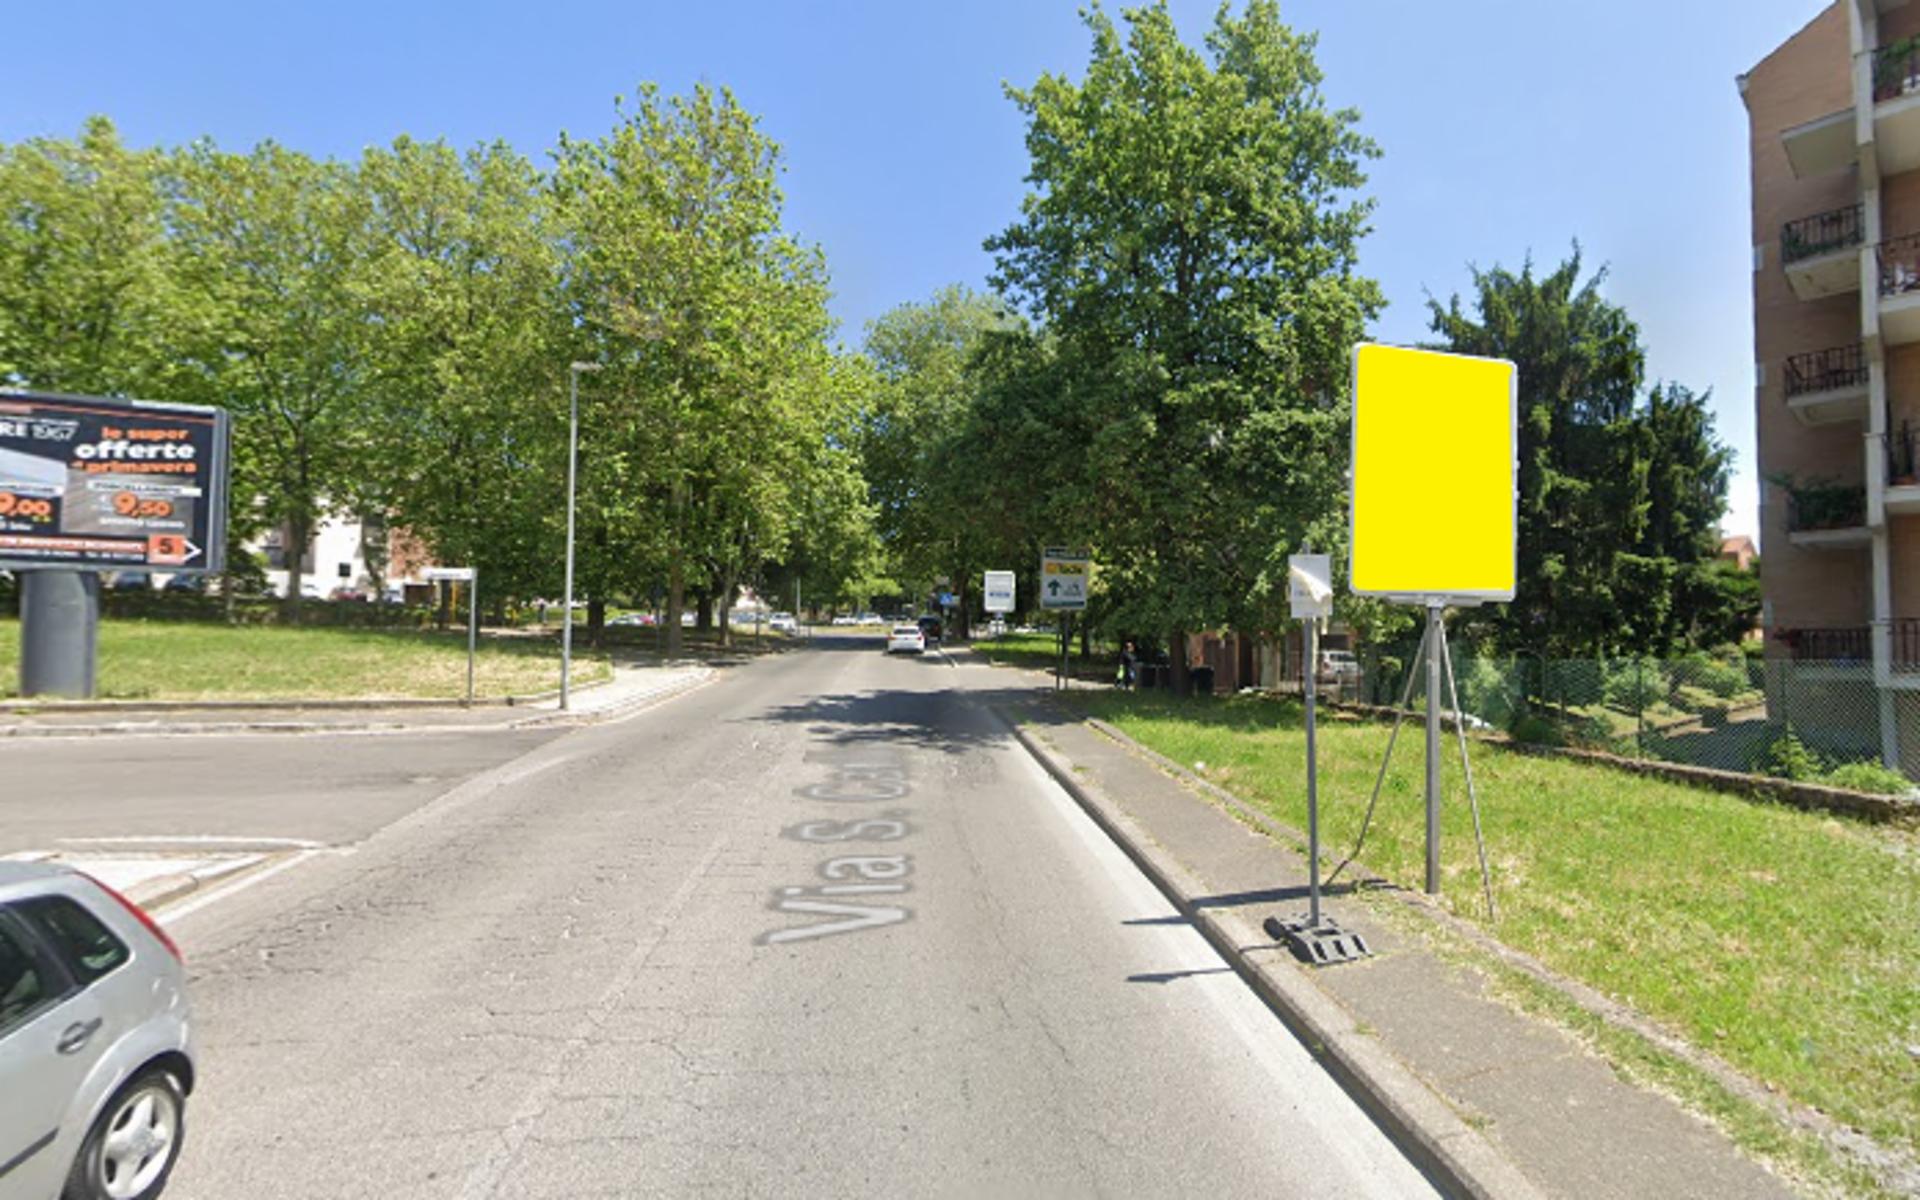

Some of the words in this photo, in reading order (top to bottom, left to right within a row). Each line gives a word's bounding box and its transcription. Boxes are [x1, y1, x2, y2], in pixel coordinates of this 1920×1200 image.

[127, 428, 189, 442] super
[75, 440, 196, 460] offerte
[85, 460, 197, 474] primavera
[158, 538, 174, 555] 5
